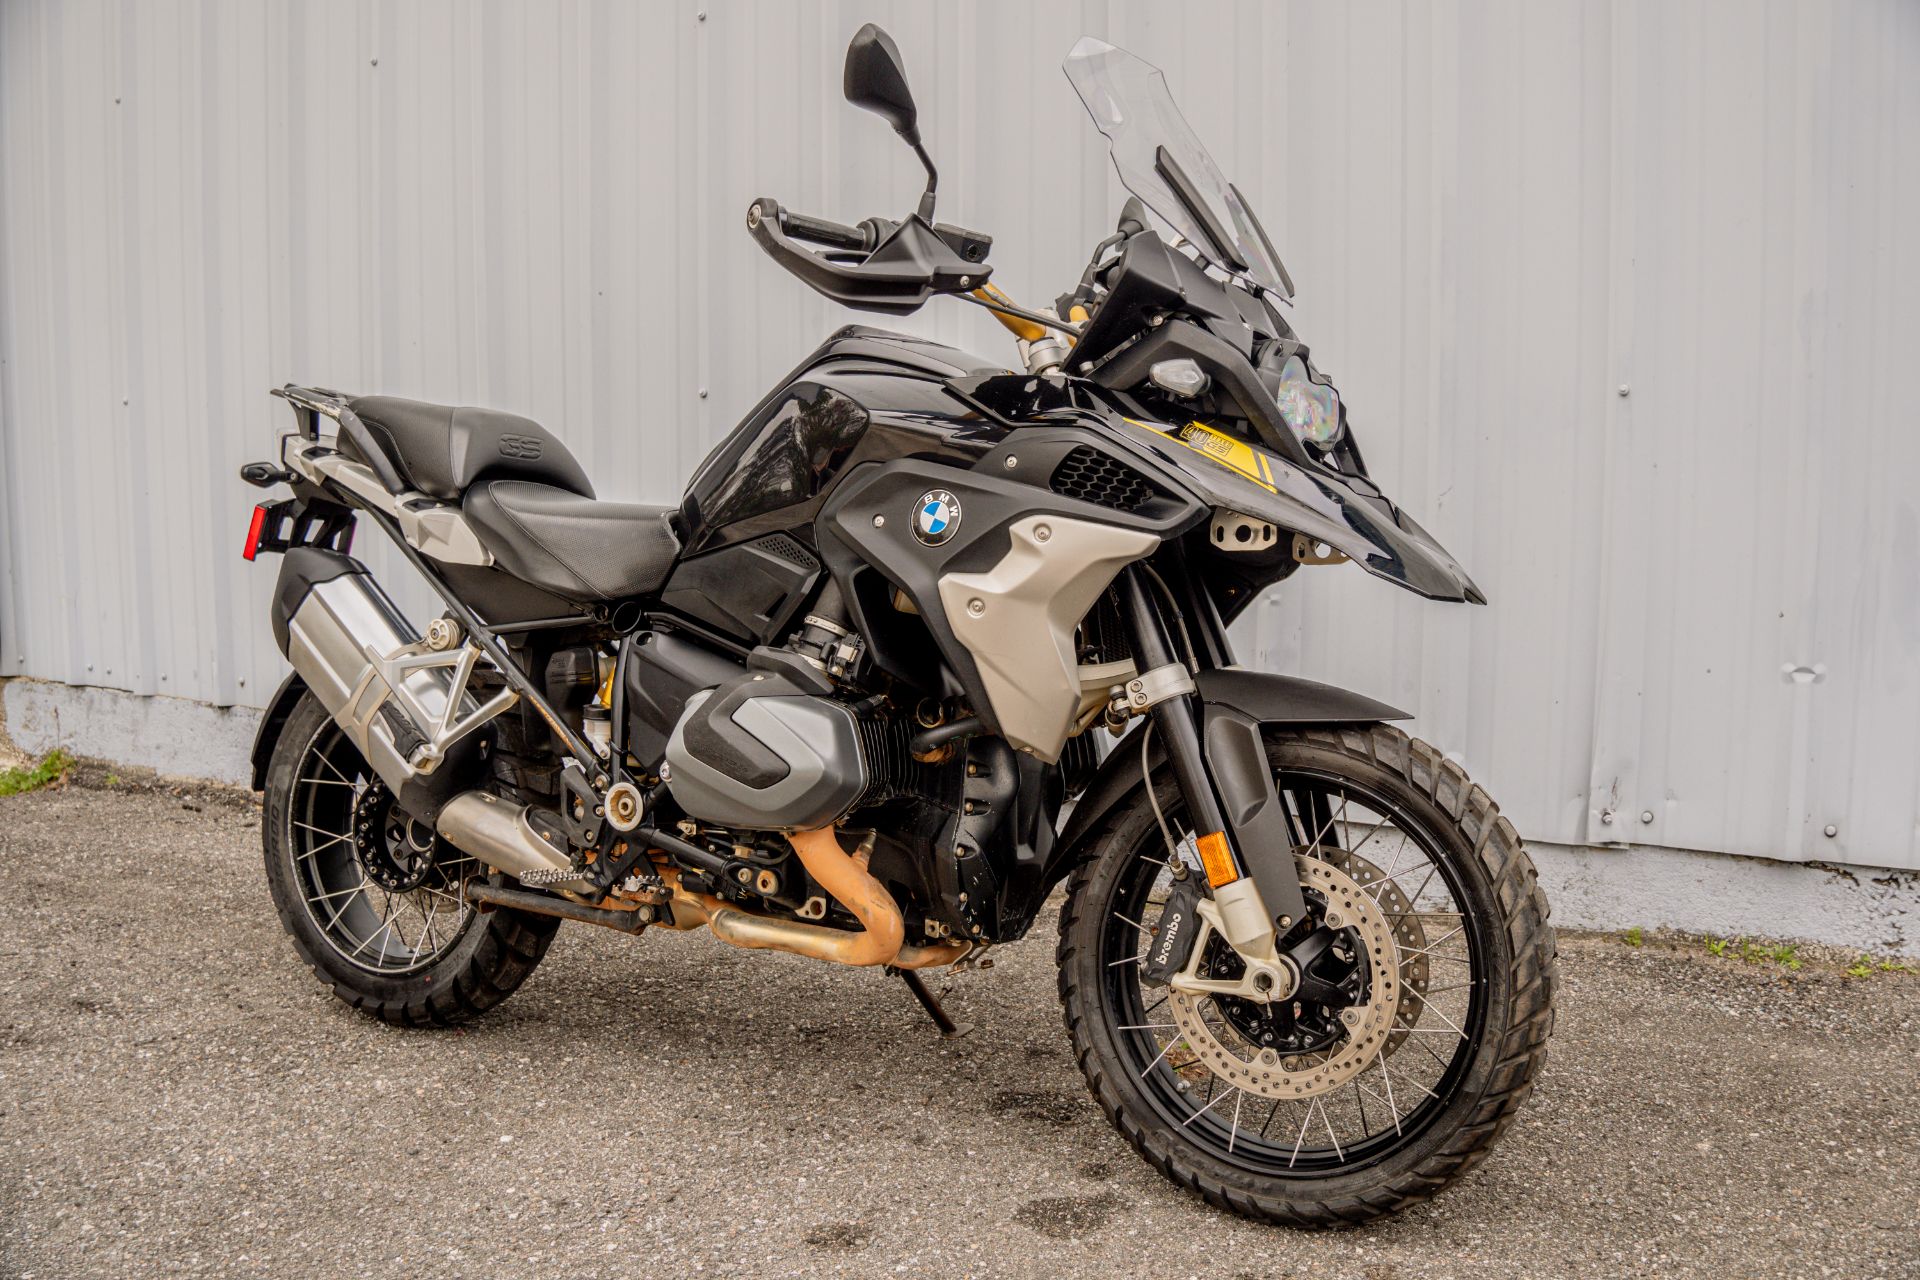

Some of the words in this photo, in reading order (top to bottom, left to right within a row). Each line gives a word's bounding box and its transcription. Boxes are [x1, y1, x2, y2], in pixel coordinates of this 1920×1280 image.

[498, 433, 544, 461] GS
[924, 492, 959, 517] BMW
[1155, 912, 1182, 965] brembo
